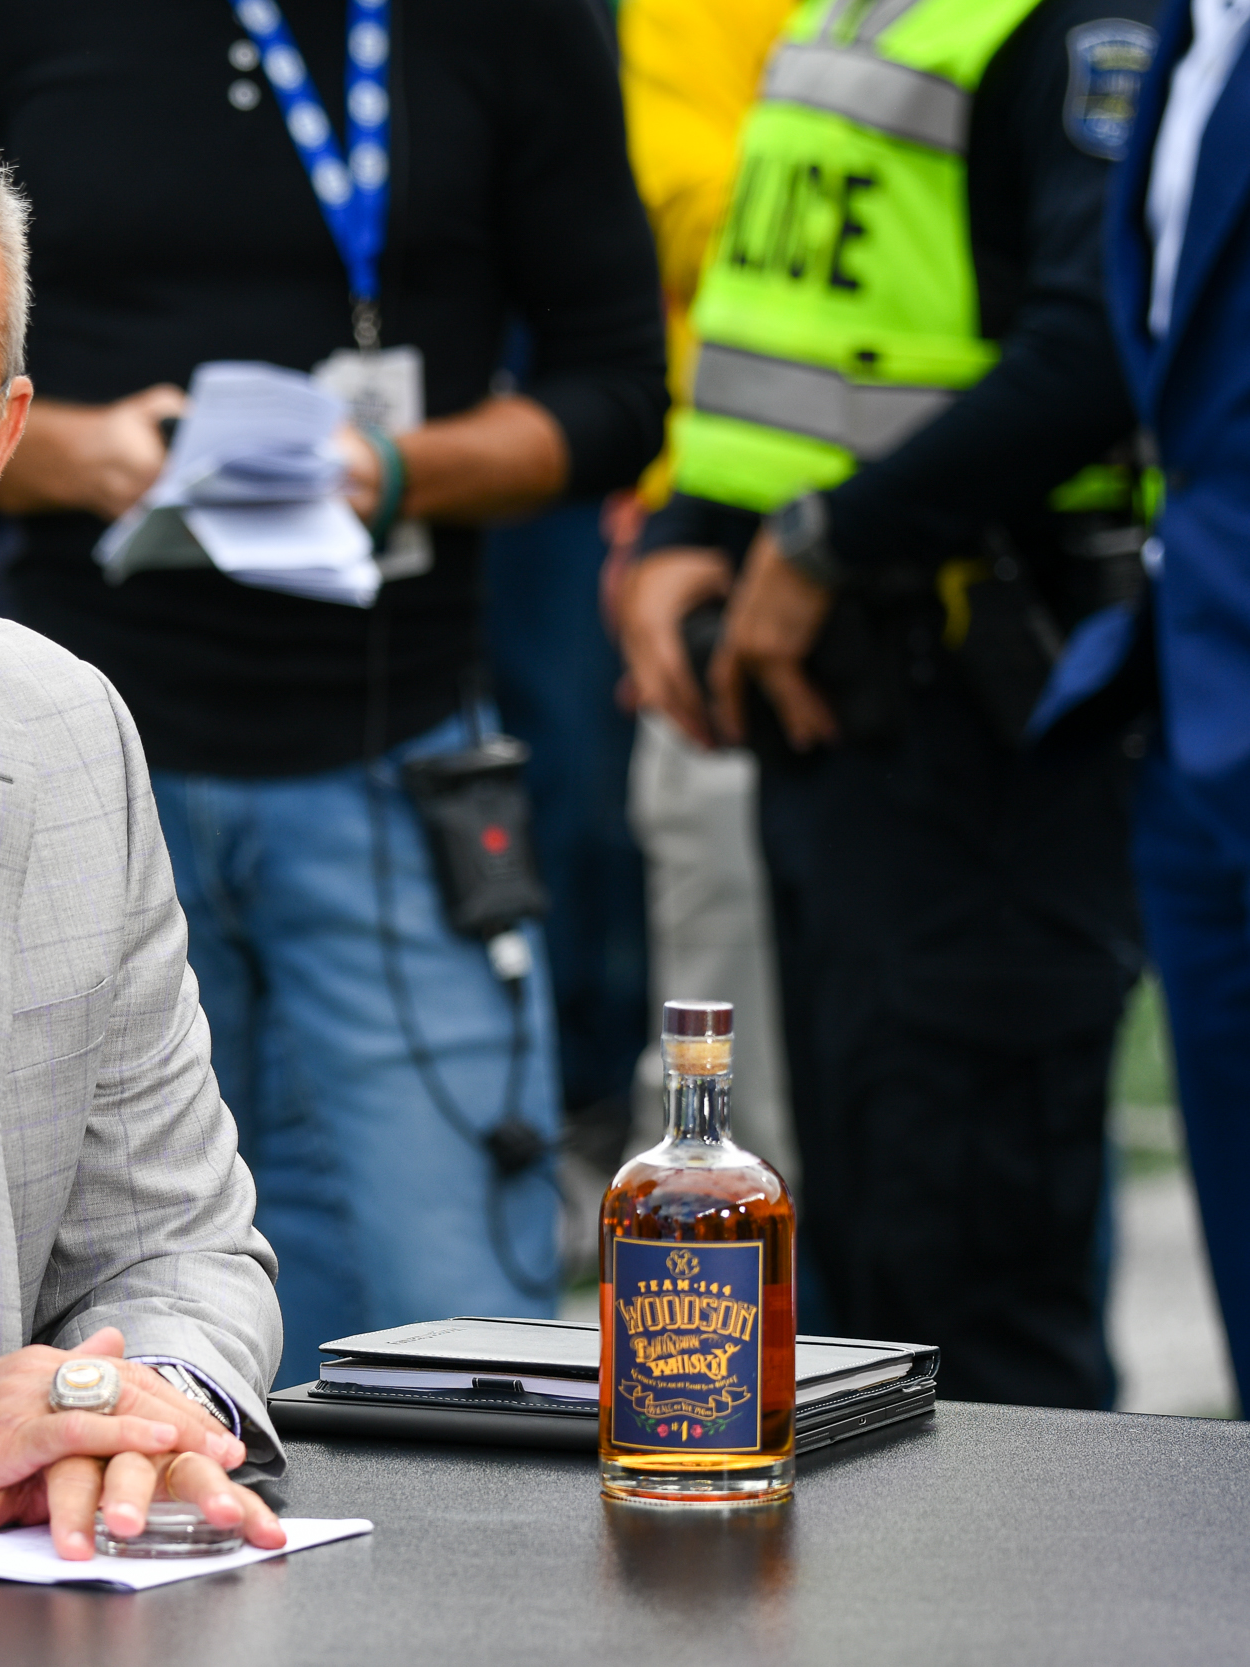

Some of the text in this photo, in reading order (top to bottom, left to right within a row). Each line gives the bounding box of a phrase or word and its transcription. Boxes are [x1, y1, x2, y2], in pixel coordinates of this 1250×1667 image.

[638, 1279, 690, 1293] TEAM
[616, 1293, 757, 1341] WOODSON
[646, 1342, 742, 1380] WHISKEY
[671, 1420, 689, 1442] #1
